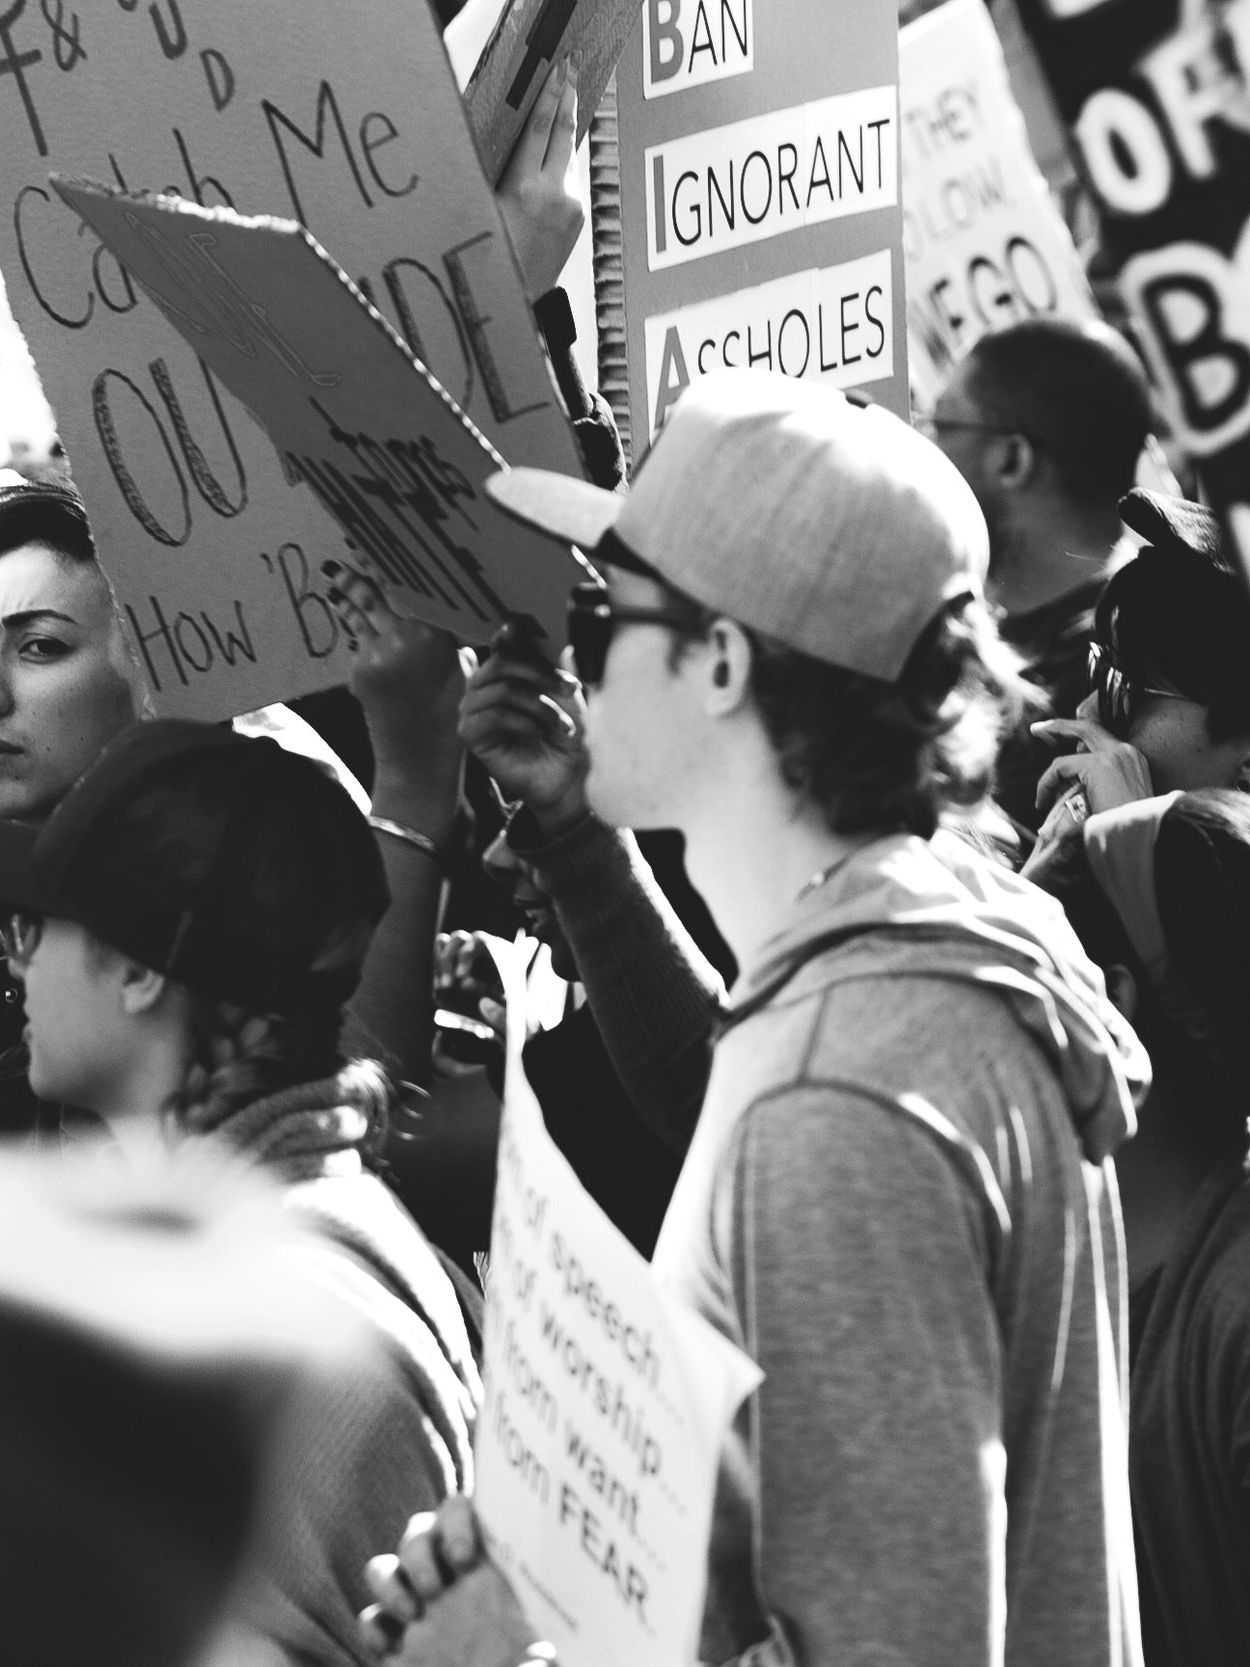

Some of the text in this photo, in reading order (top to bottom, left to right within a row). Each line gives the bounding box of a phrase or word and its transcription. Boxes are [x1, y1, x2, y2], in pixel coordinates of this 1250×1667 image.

[650, 0, 748, 84] BAN
[13, 79, 420, 329] Cah Me
[653, 118, 891, 255] IGNORANT
[93, 230, 550, 548] OUDE
[653, 285, 886, 430] ASSHOLES
[124, 595, 258, 692] How
